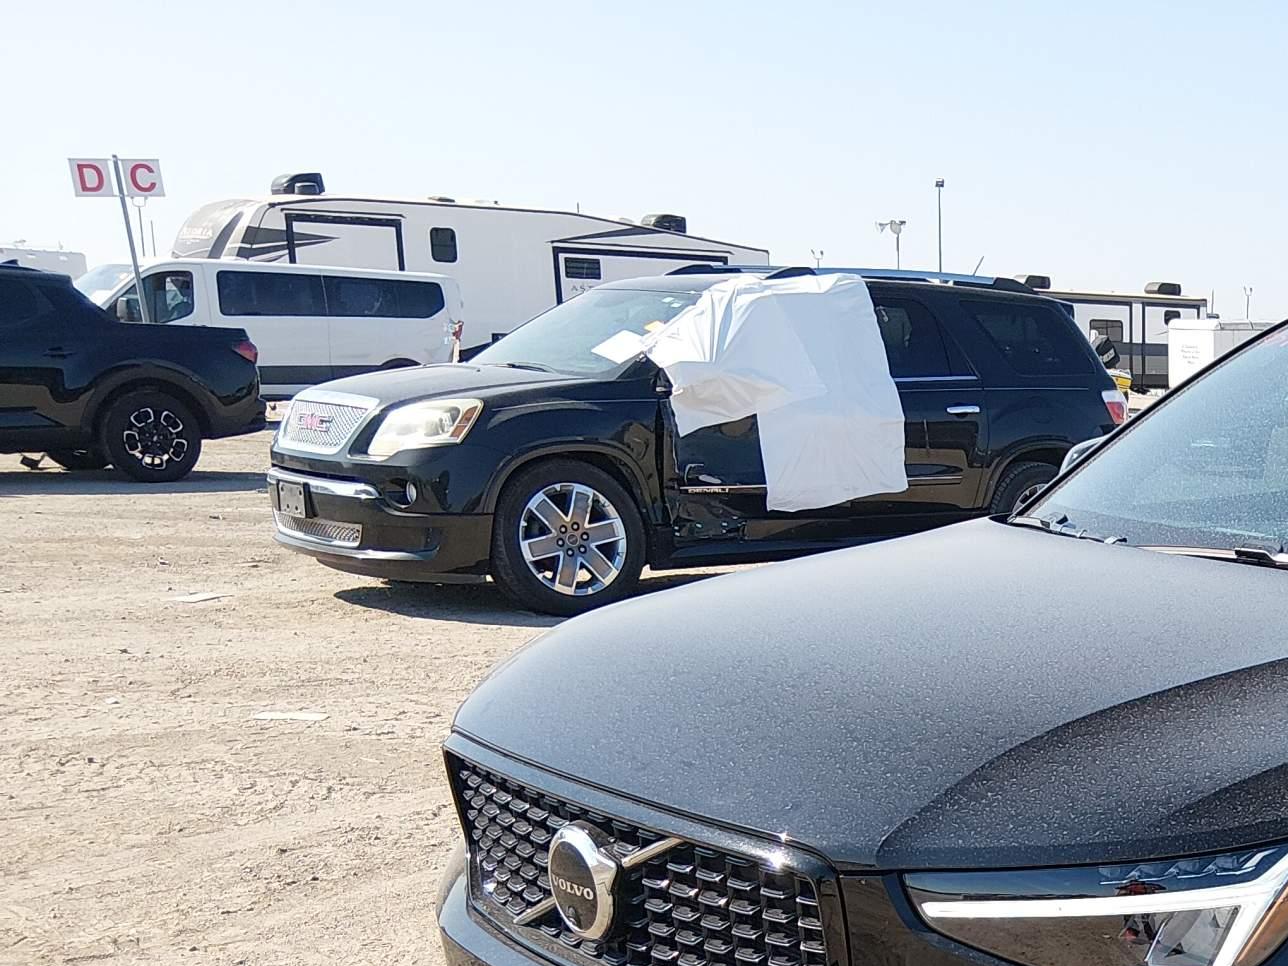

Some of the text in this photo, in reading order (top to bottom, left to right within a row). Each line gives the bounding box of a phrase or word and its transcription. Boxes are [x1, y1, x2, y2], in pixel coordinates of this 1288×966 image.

[76, 163, 105, 193] D
[130, 163, 157, 193] C
[298, 413, 335, 433] GMC
[551, 872, 595, 901] VOLVO
